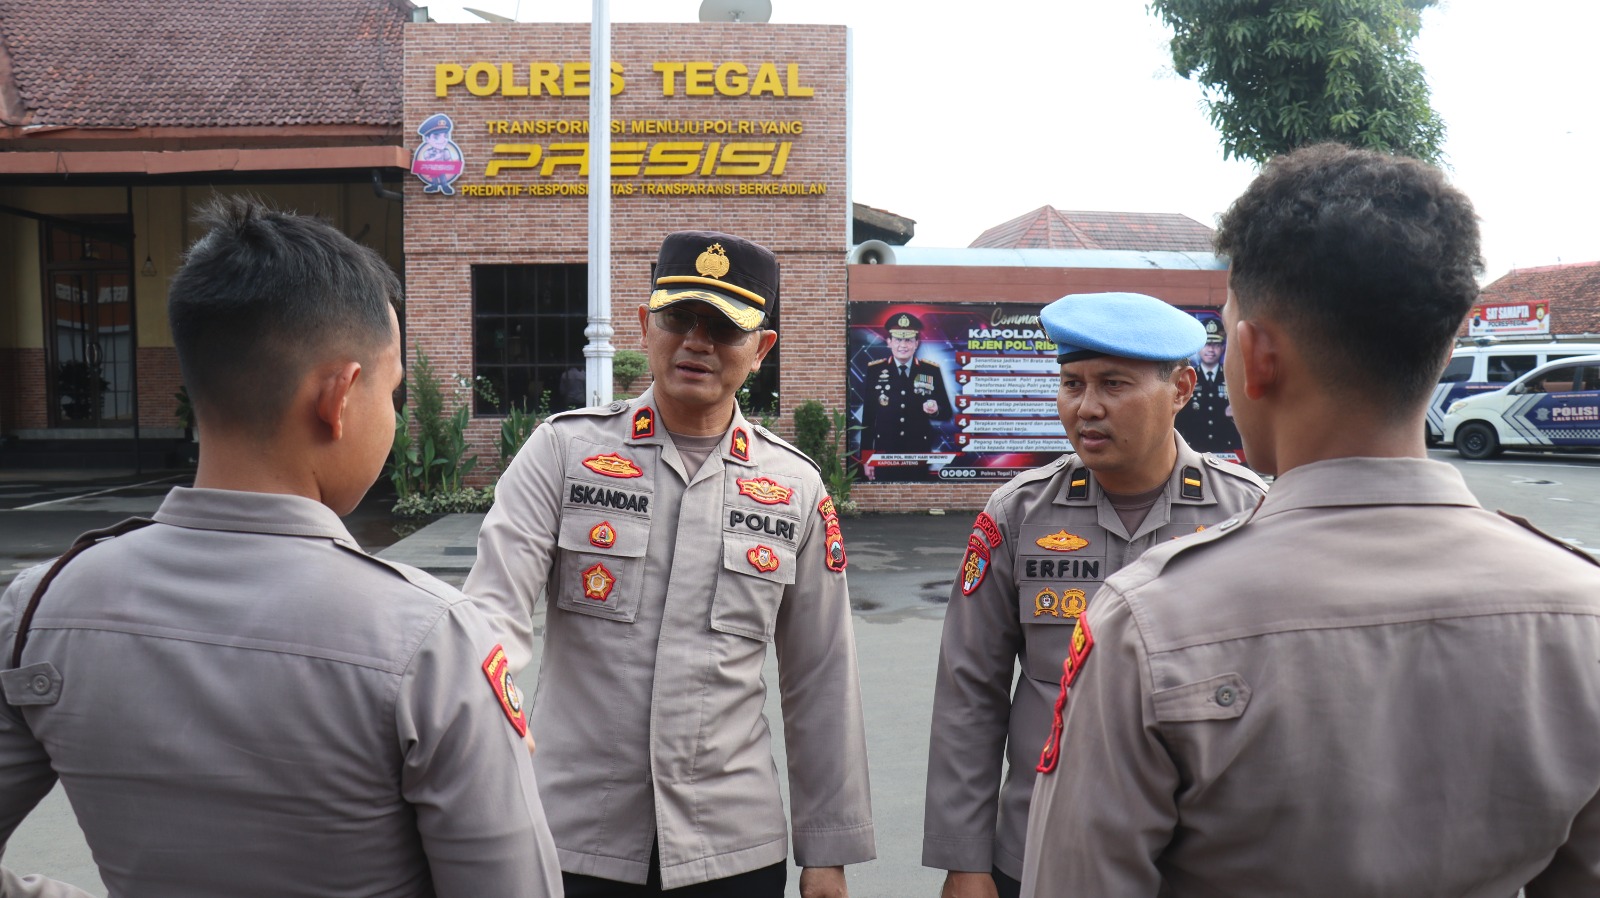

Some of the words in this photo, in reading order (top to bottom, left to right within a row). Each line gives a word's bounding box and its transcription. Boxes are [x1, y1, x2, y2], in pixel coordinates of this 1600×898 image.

[653, 61, 814, 97] TEGAL
[631, 120, 699, 134] MENUJU
[703, 120, 754, 134] POLRI
[759, 120, 803, 134] YANG
[739, 183, 827, 195] BERKEADILAN
[1486, 307, 1498, 320] SAT
[968, 328, 1046, 339] KAPOLDA
[967, 340, 1003, 350] IRJEN
[1005, 340, 1033, 350] POL.
[960, 355, 966, 364] 1
[959, 374, 967, 383] 2
[959, 398, 966, 407] 3
[1552, 406, 1598, 417] POLISI
[958, 418, 967, 427] 4
[958, 436, 966, 444] 5
[569, 483, 649, 513] ISKANDAR
[729, 509, 795, 540] POLRI
[1025, 559, 1099, 578] ERFIN
